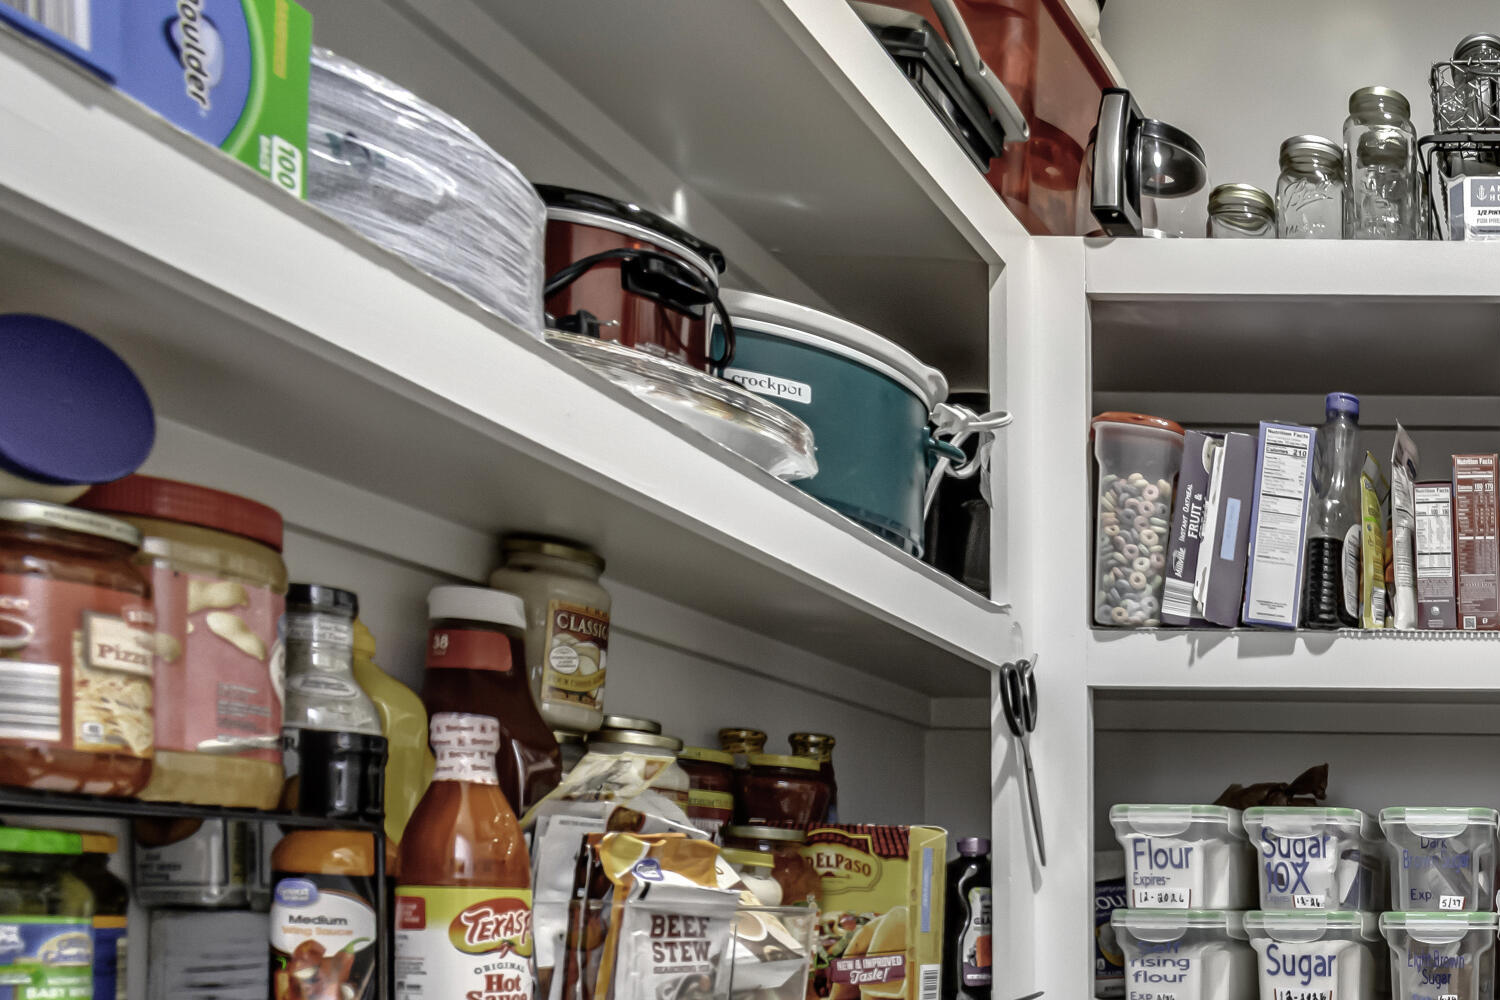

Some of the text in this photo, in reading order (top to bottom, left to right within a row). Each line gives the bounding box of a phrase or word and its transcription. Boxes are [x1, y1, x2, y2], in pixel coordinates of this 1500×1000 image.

[179, 0, 209, 107] oulder
[278, 146, 296, 190] 100
[1293, 448, 1307, 458] 210
[1188, 503, 1202, 540] FRUIT
[1132, 838, 1193, 870] Flour
[1262, 827, 1331, 864] Sugar
[1265, 861, 1311, 894] 10X
[1410, 889, 1432, 901] Exp
[288, 914, 348, 926] Medium
[651, 914, 711, 939] BEEF
[653, 940, 712, 964] STEW
[474, 961, 524, 975] ORIGINAL
[837, 959, 855, 971] NEW
[862, 956, 903, 969] IMPROVED
[1130, 956, 1191, 971] rising
[1266, 943, 1336, 985] Sugar
[484, 973, 521, 993] Hot
[850, 968, 890, 985] Taste!
[1132, 971, 1187, 983] flour
[1422, 968, 1452, 988] Sugar
[1130, 991, 1153, 1000] Exp
